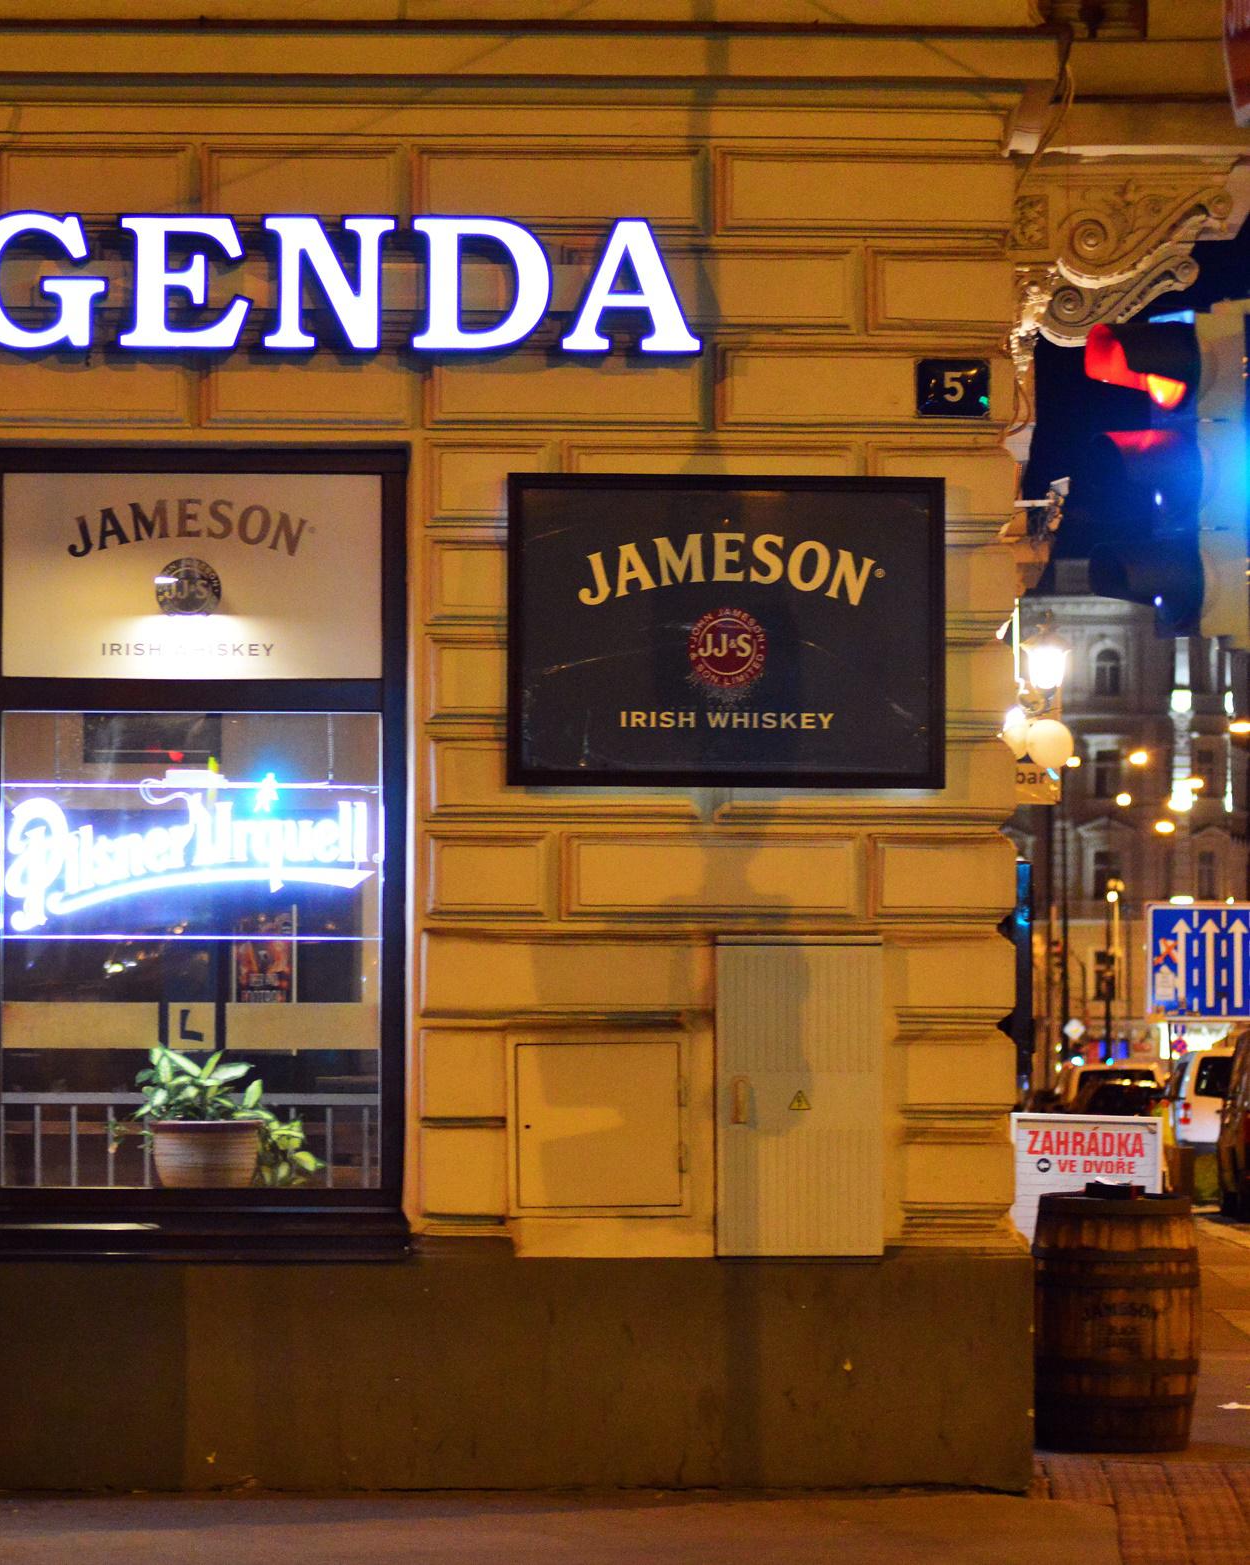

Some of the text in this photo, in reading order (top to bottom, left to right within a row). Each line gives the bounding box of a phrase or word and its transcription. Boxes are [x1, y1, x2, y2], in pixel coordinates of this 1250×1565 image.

[943, 371, 965, 402] 5
[101, 643, 161, 656] IRISH
[697, 633, 753, 658] JJ&S
[619, 710, 835, 729] IRISH WHISKEY
[4, 790, 368, 931] Pilsner Urquell
[180, 1009, 204, 1042] L
[1027, 1126, 1145, 1158] ZAHRÁDKA
[1057, 1157, 1136, 1174] VE DVOŘE
